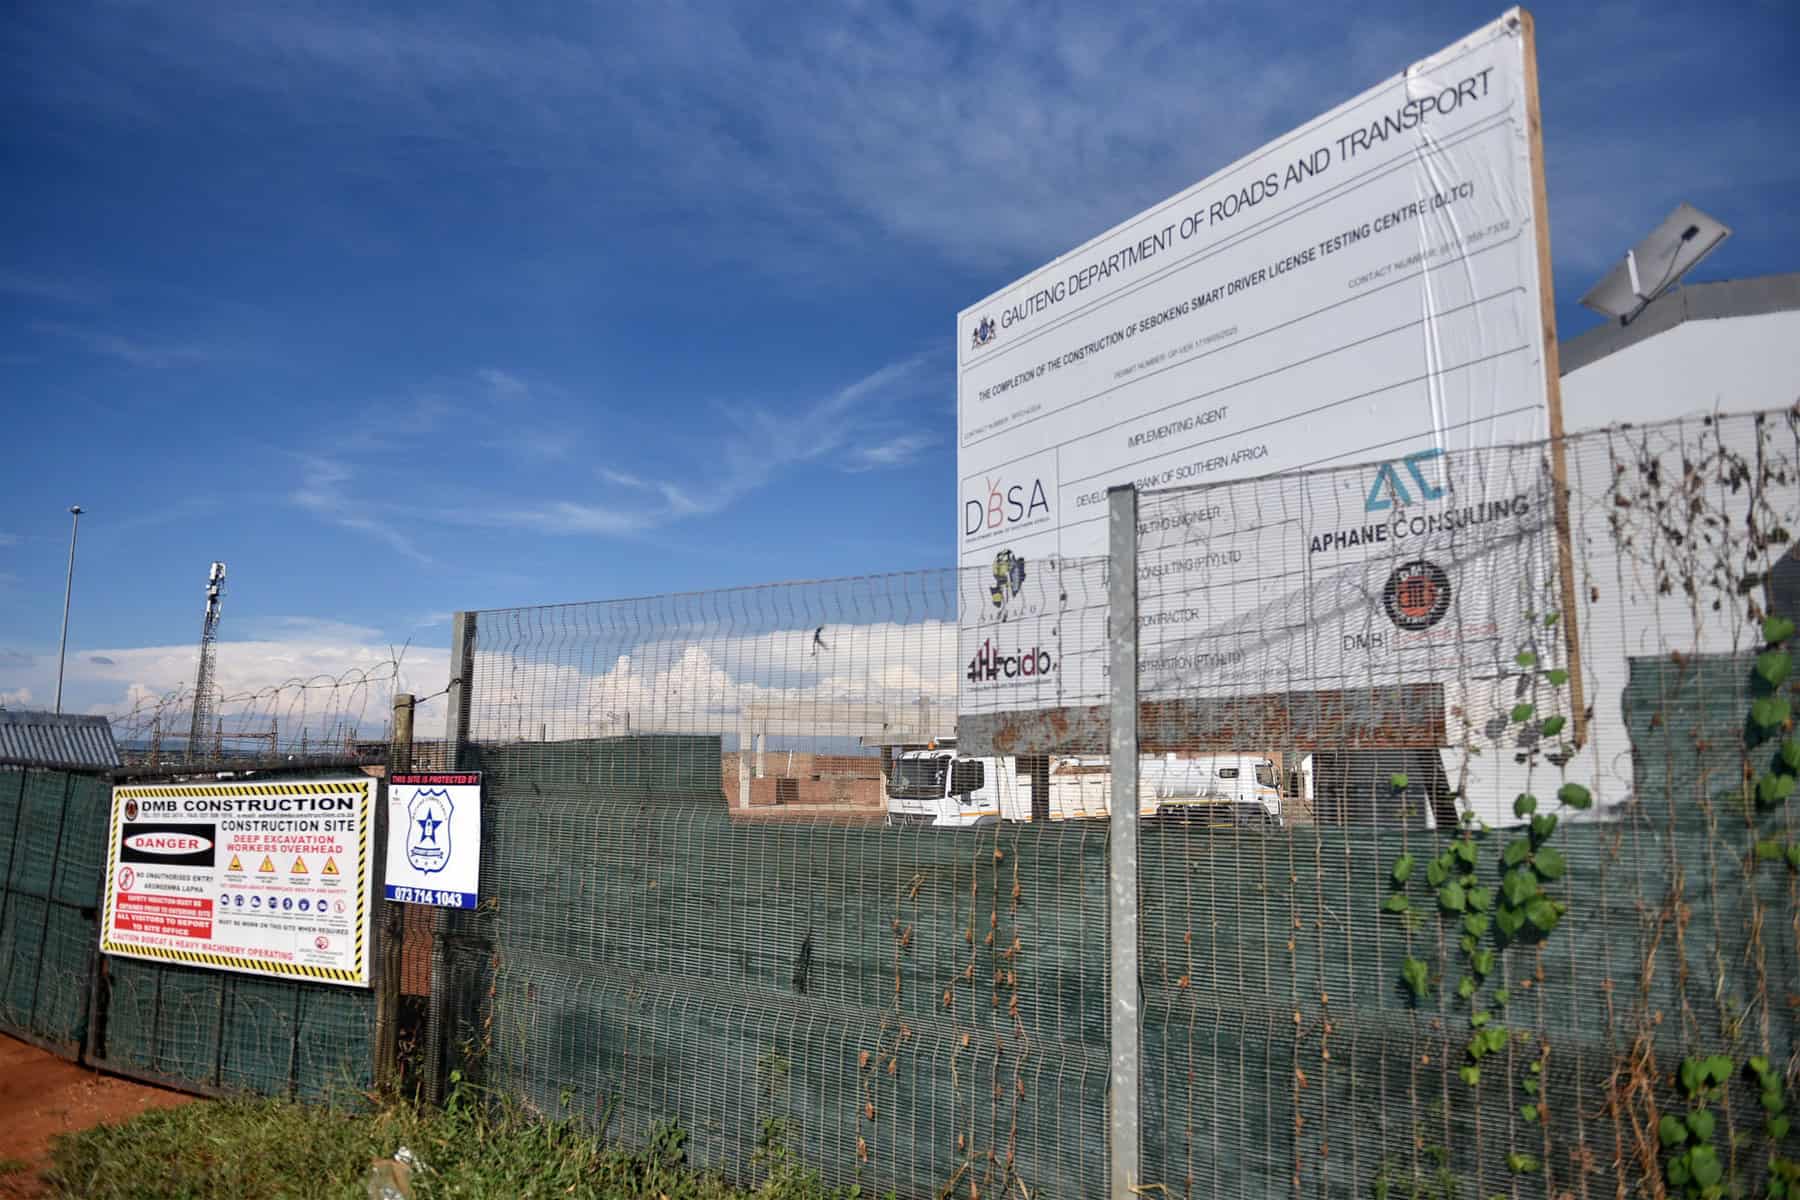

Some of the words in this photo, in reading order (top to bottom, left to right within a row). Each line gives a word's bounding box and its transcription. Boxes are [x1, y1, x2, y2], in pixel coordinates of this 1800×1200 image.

[1001, 283, 1066, 329] GAUTENG
[1068, 227, 1174, 297] DEPARTMENT
[1180, 210, 1205, 239] OF
[1209, 172, 1280, 226] ROADS
[1284, 148, 1331, 190] AND
[1336, 66, 1494, 161] TRANSPORT
[978, 388, 992, 401] THE
[992, 367, 1036, 395] COMPLETION
[1036, 364, 1047, 377] OF
[1047, 357, 1062, 372] THE
[1062, 332, 1125, 368] CONSTRUCTION
[1125, 324, 1138, 339] OF
[1139, 301, 1190, 333] SEBOKENG
[1191, 286, 1226, 311] SMART
[1227, 268, 1266, 296] DRIVER
[1268, 247, 1316, 279] LICENSE
[1318, 223, 1371, 257] TESTING
[1373, 199, 1426, 233] CENTRE
[1128, 418, 1194, 449] IMPLEMENTING
[1195, 405, 1229, 427] AGENT
[1136, 474, 1161, 490] BANK
[1161, 470, 1175, 485] OF
[1176, 455, 1229, 481] SOUTHERN
[1231, 444, 1269, 465] AFRICA
[965, 478, 1049, 537] DBSA
[1310, 523, 1387, 553] APHANE
[1393, 494, 1529, 538] CONSULTING
[1342, 633, 1384, 651] DMB
[1004, 648, 1051, 678] cidb
[428, 775, 466, 784] PROTECTED
[467, 775, 478, 784] BY
[142, 800, 177, 812] DMB
[183, 798, 354, 812] CONSTRUCTION
[221, 820, 319, 832] CONSTRUCTION
[324, 820, 355, 832] SITE
[135, 838, 200, 849] DANGER
[226, 843, 278, 853] WORKERS
[280, 844, 343, 854] OVERHEAD
[233, 835, 260, 843] DEEP
[263, 835, 335, 844] EXCAVATION
[394, 887, 413, 900] 073
[413, 889, 433, 904] 714
[434, 891, 463, 907] 1043
[166, 917, 176, 925] TO
[247, 946, 294, 961] OPERATING
